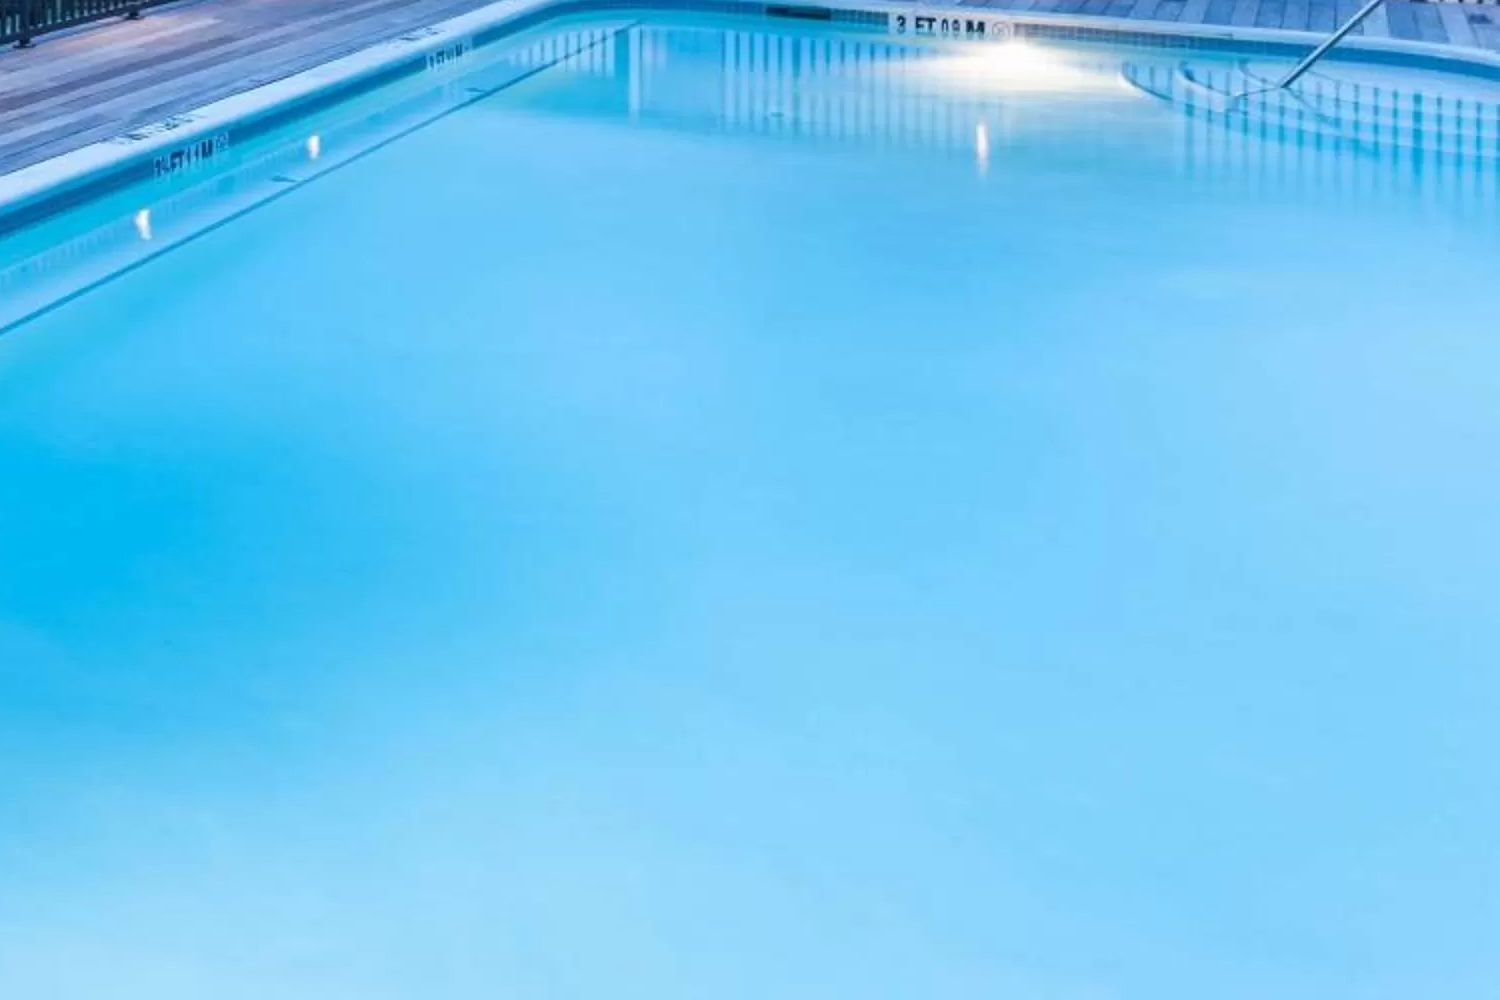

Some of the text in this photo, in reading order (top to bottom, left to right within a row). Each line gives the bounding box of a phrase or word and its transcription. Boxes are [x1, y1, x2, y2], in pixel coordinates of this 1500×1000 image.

[896, 15, 907, 34] 3
[915, 16, 937, 35] FT
[966, 20, 985, 36] M
